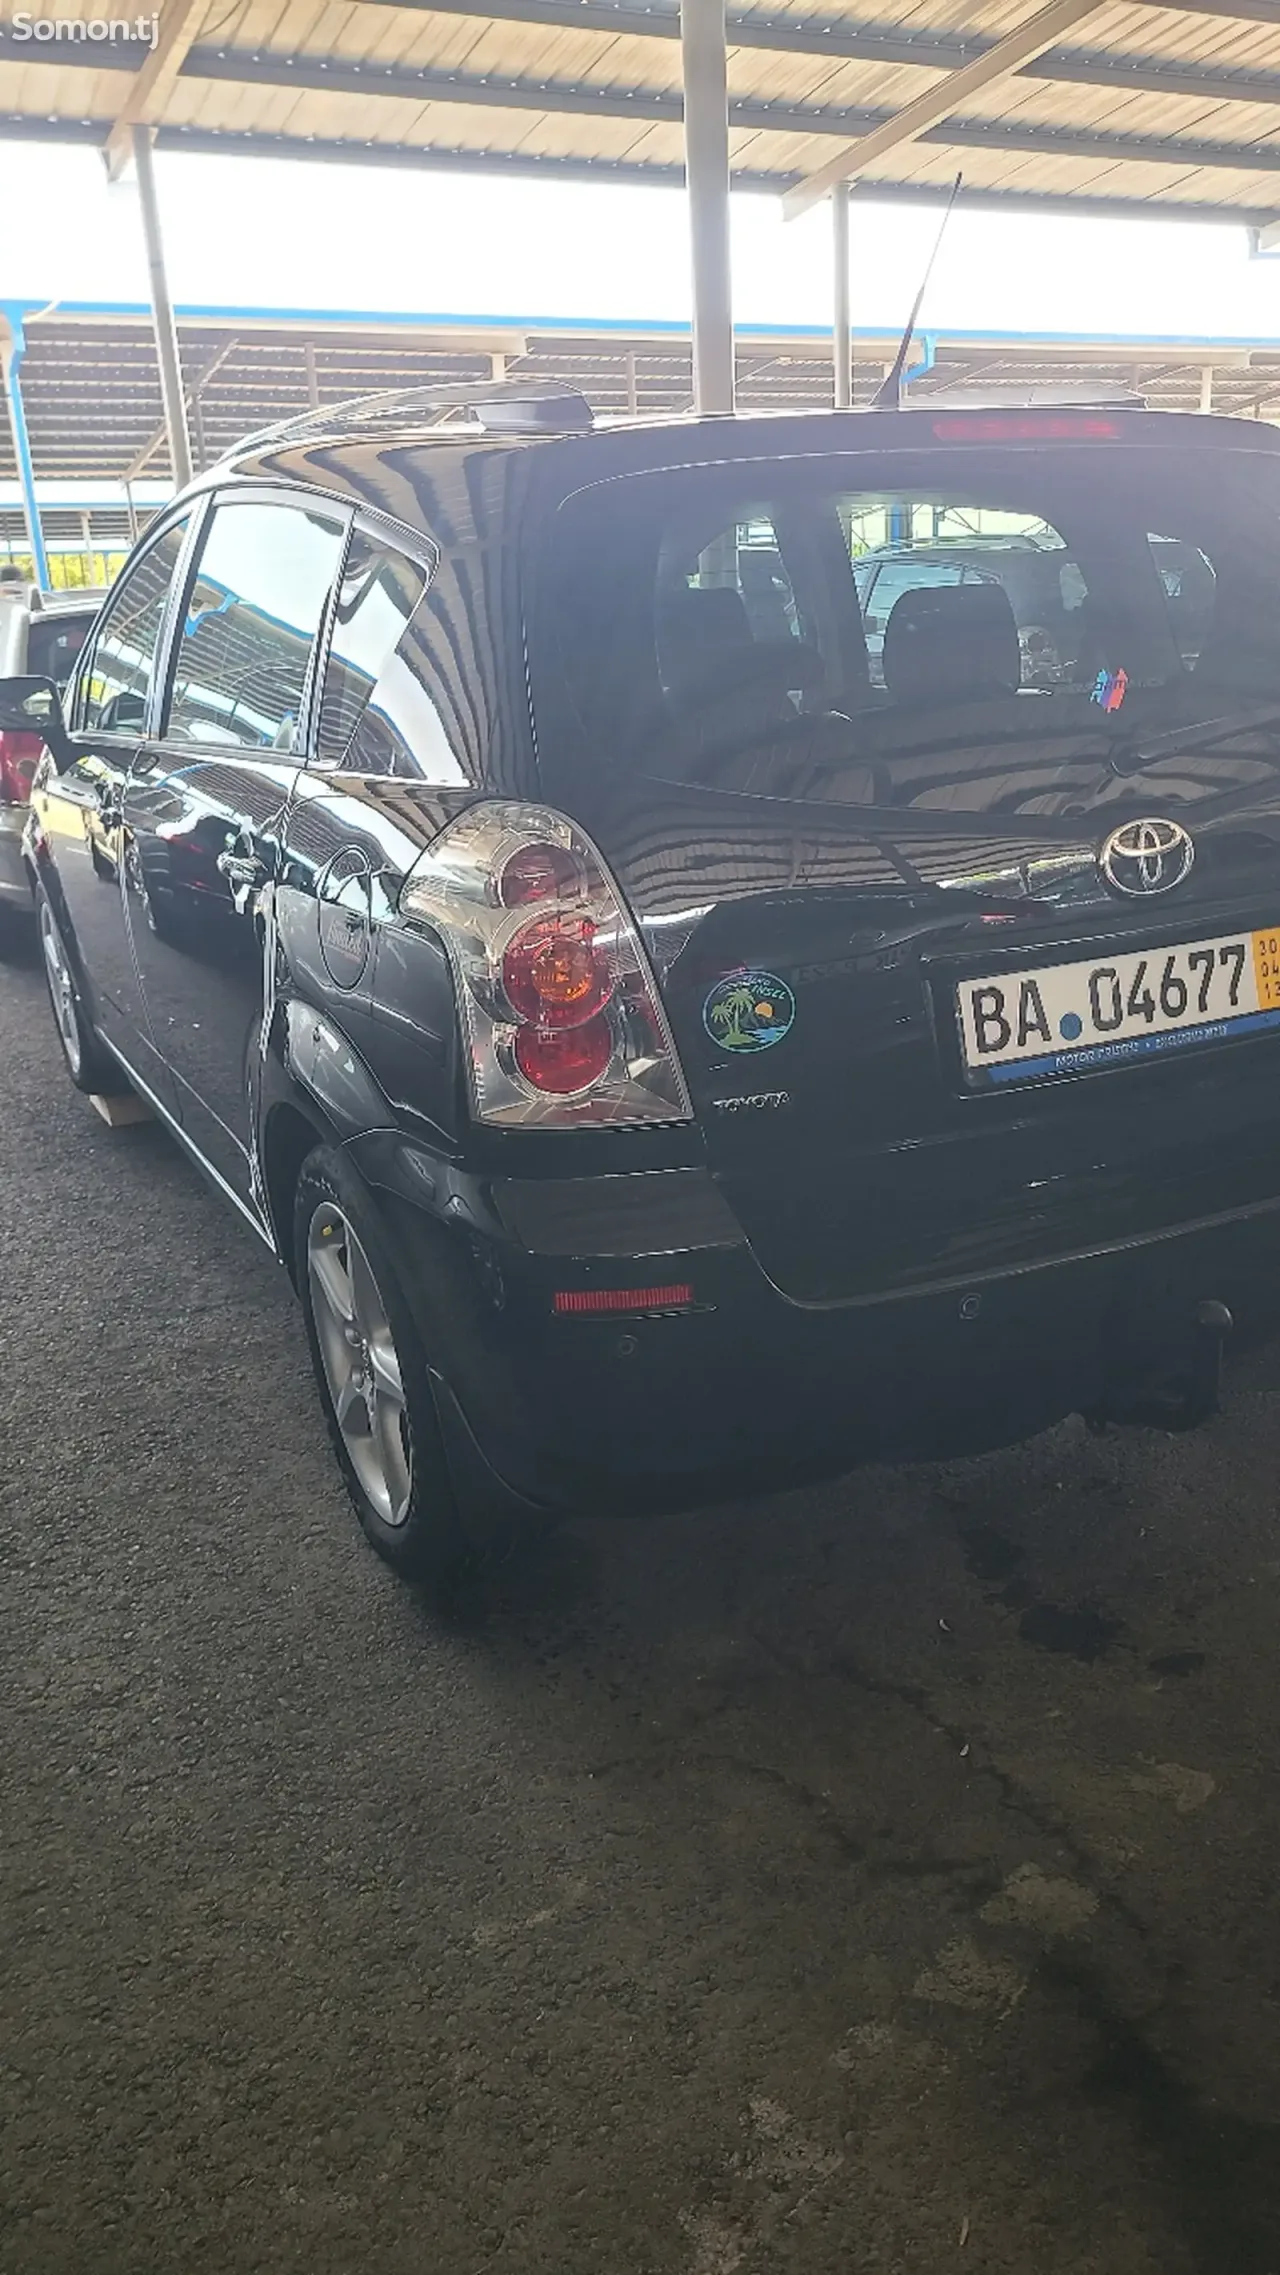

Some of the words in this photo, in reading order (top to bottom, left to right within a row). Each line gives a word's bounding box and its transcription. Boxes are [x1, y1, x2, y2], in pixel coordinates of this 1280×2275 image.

[1259, 938, 1278, 957] 30
[971, 979, 1052, 1055] BA
[1088, 944, 1247, 1032] 04677
